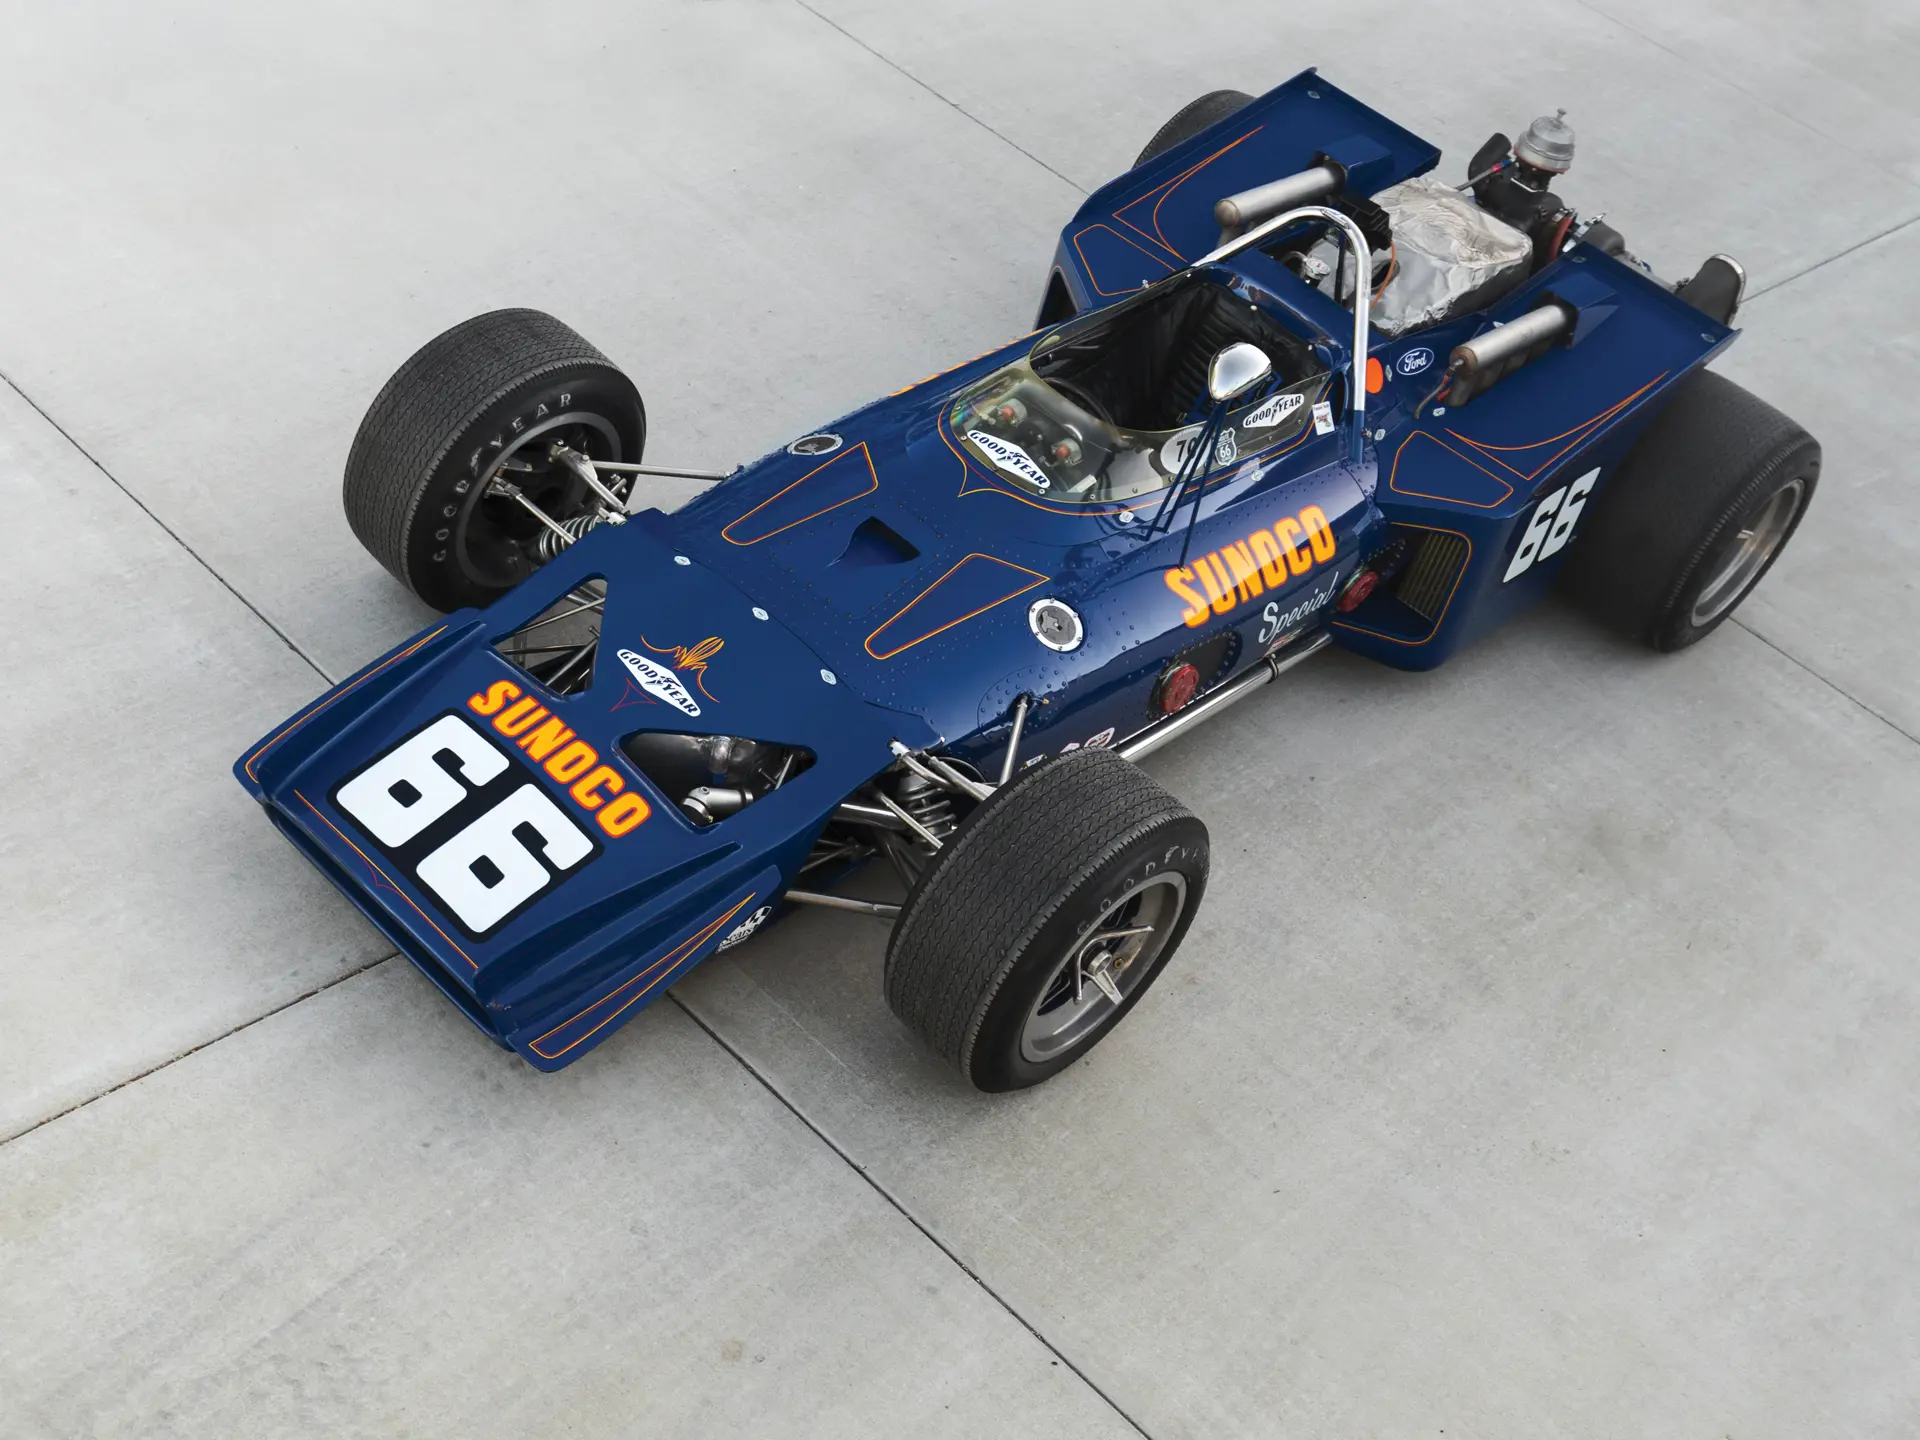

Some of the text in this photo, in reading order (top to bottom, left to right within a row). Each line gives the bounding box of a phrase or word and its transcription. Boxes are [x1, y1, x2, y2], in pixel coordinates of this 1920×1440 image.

[1404, 351, 1427, 372] Ford
[1245, 395, 1301, 426] GOODYEAR
[433, 393, 571, 562] GOODYEAR
[970, 431, 1047, 486] GOODYEAR
[1219, 444, 1231, 459] 66
[1503, 466, 1601, 583] 66
[1164, 504, 1337, 628] SUNOCO
[1258, 571, 1339, 645] Special
[620, 651, 698, 713] GOODYEAR
[467, 679, 652, 839] SUNOCO
[335, 714, 594, 933] 66
